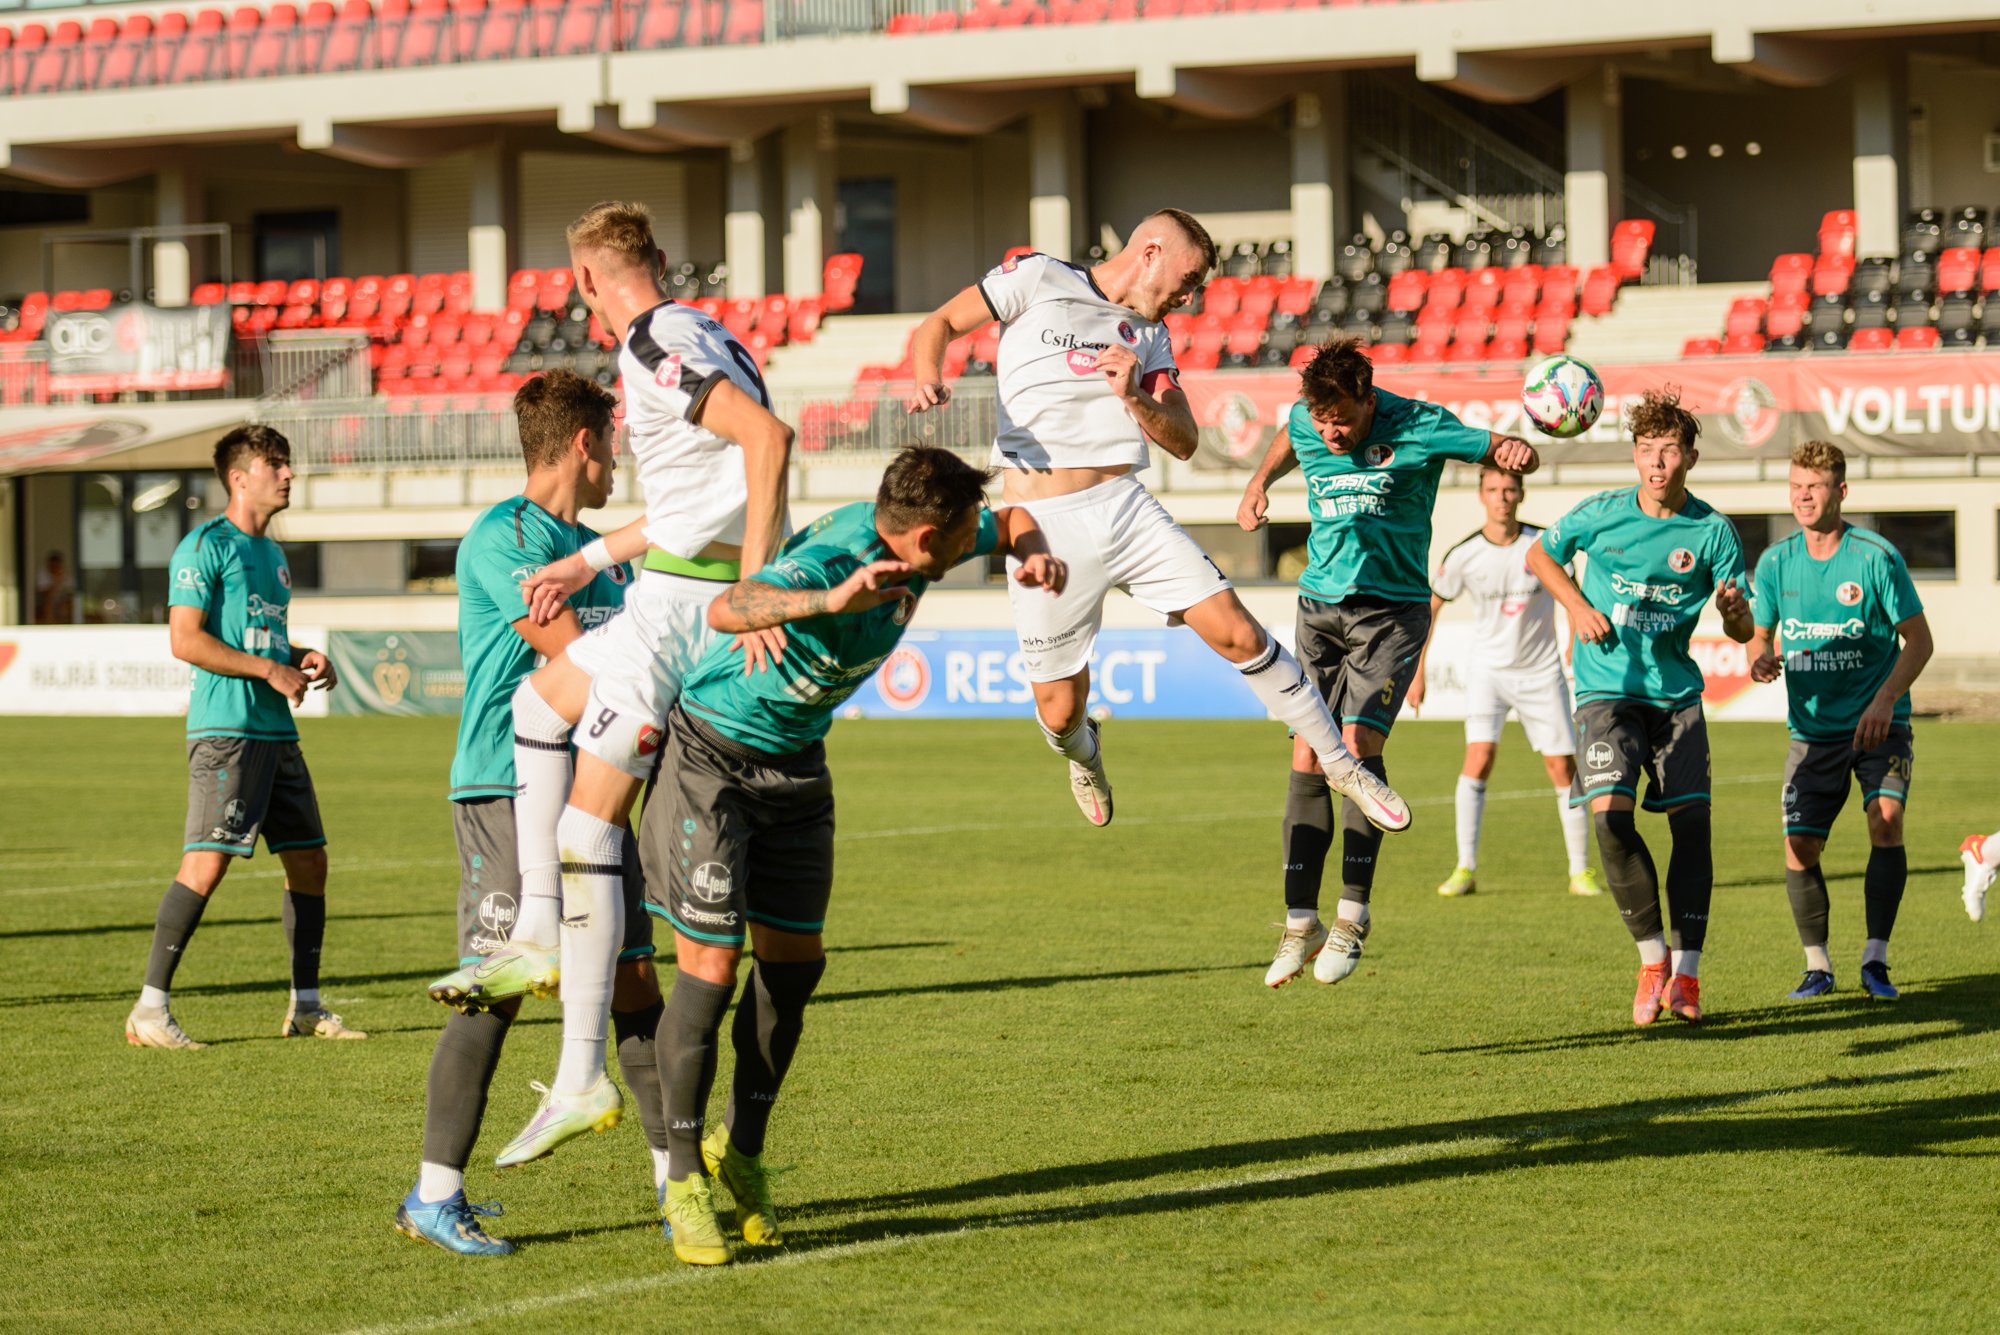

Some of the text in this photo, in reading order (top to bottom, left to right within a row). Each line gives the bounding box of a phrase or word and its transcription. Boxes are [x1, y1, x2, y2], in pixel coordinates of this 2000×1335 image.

[1337, 502, 1386, 516] INSTAL
[1814, 649, 1863, 662] MELINDA
[1814, 660, 1863, 672] INSTAL
[944, 650, 1167, 704] RESCT
[1381, 678, 1395, 706] 5
[589, 708, 620, 739] 9
[1888, 756, 1910, 780] 20
[1344, 855, 1372, 864] JAKO
[672, 1116, 704, 1130] JAKO
